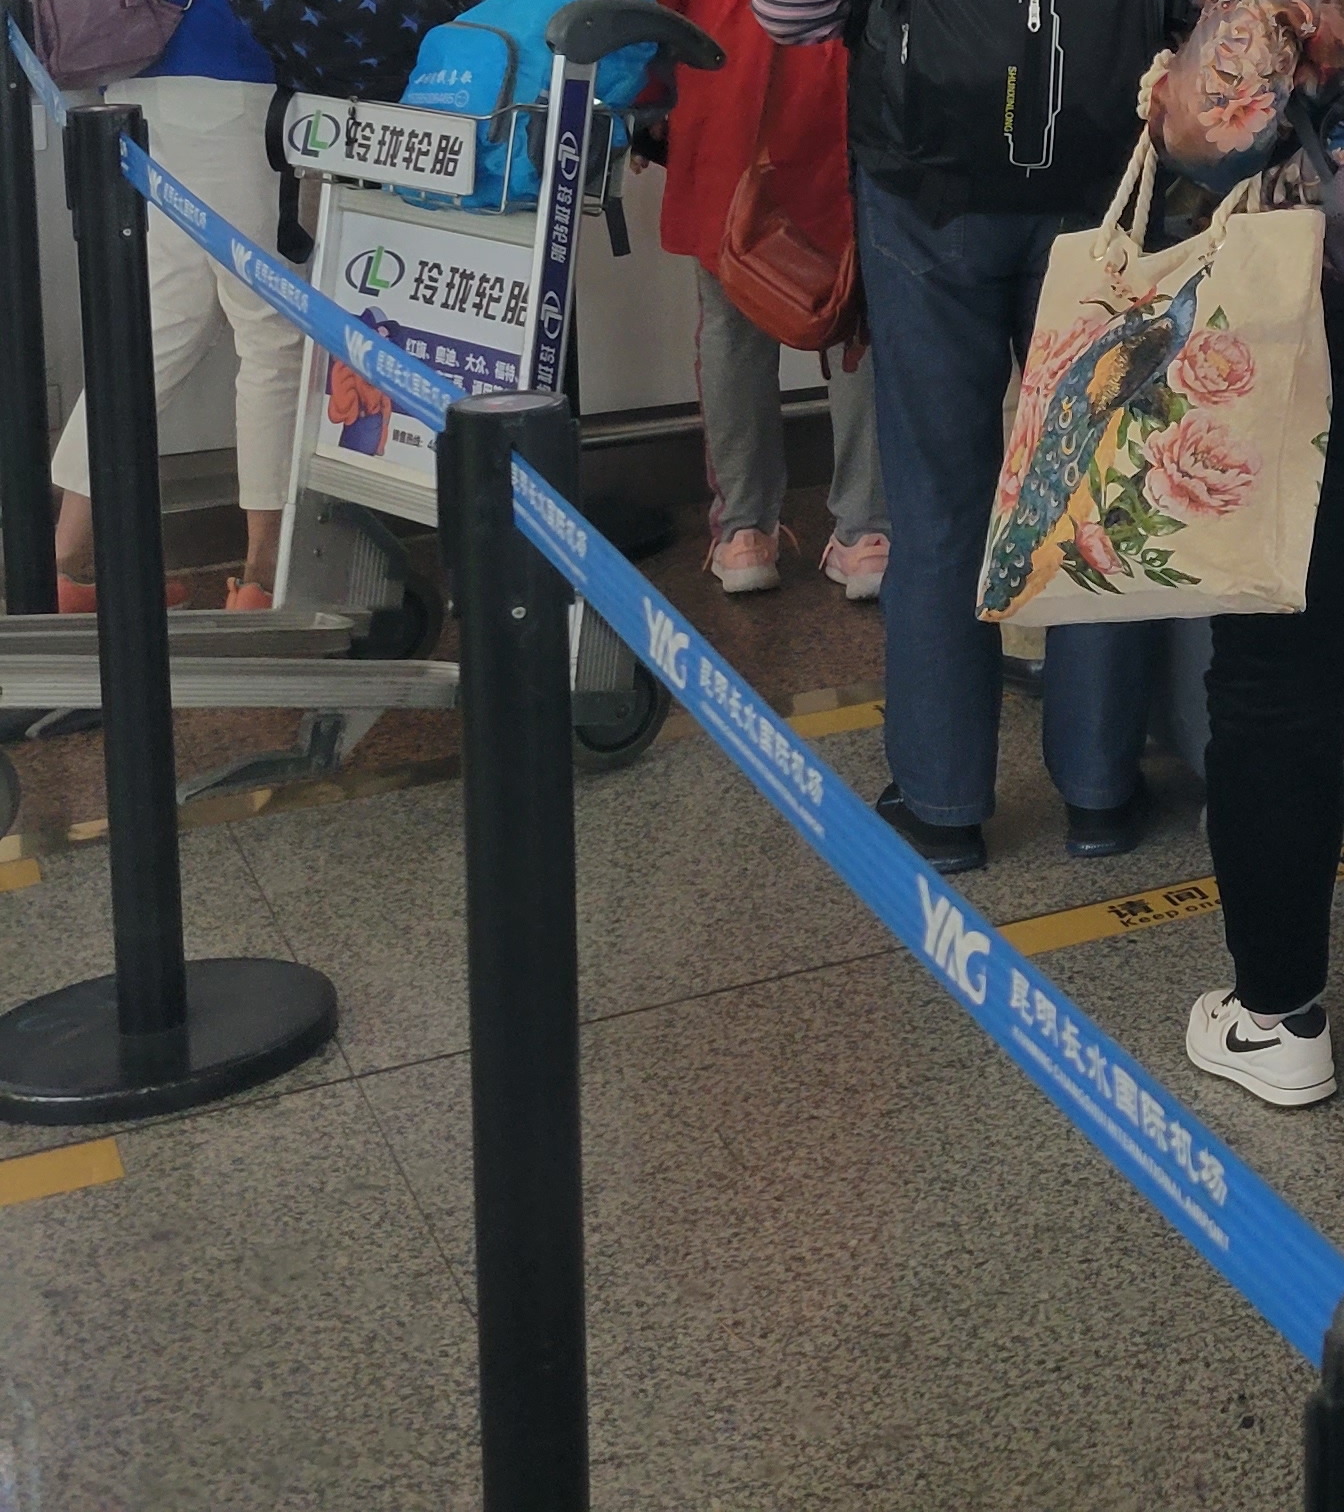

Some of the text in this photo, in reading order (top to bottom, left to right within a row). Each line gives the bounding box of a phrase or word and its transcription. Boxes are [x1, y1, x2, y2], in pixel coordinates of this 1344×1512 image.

[345, 121, 464, 177] 玲珑轮胎
[551, 184, 574, 264] 玲珑轮胎
[700, 656, 825, 806] 昆明长水国际机场
[1107, 886, 1210, 920] 请间
[1120, 906, 1181, 928] Keep
[1011, 968, 1228, 1207] 昆明长水国际机场
